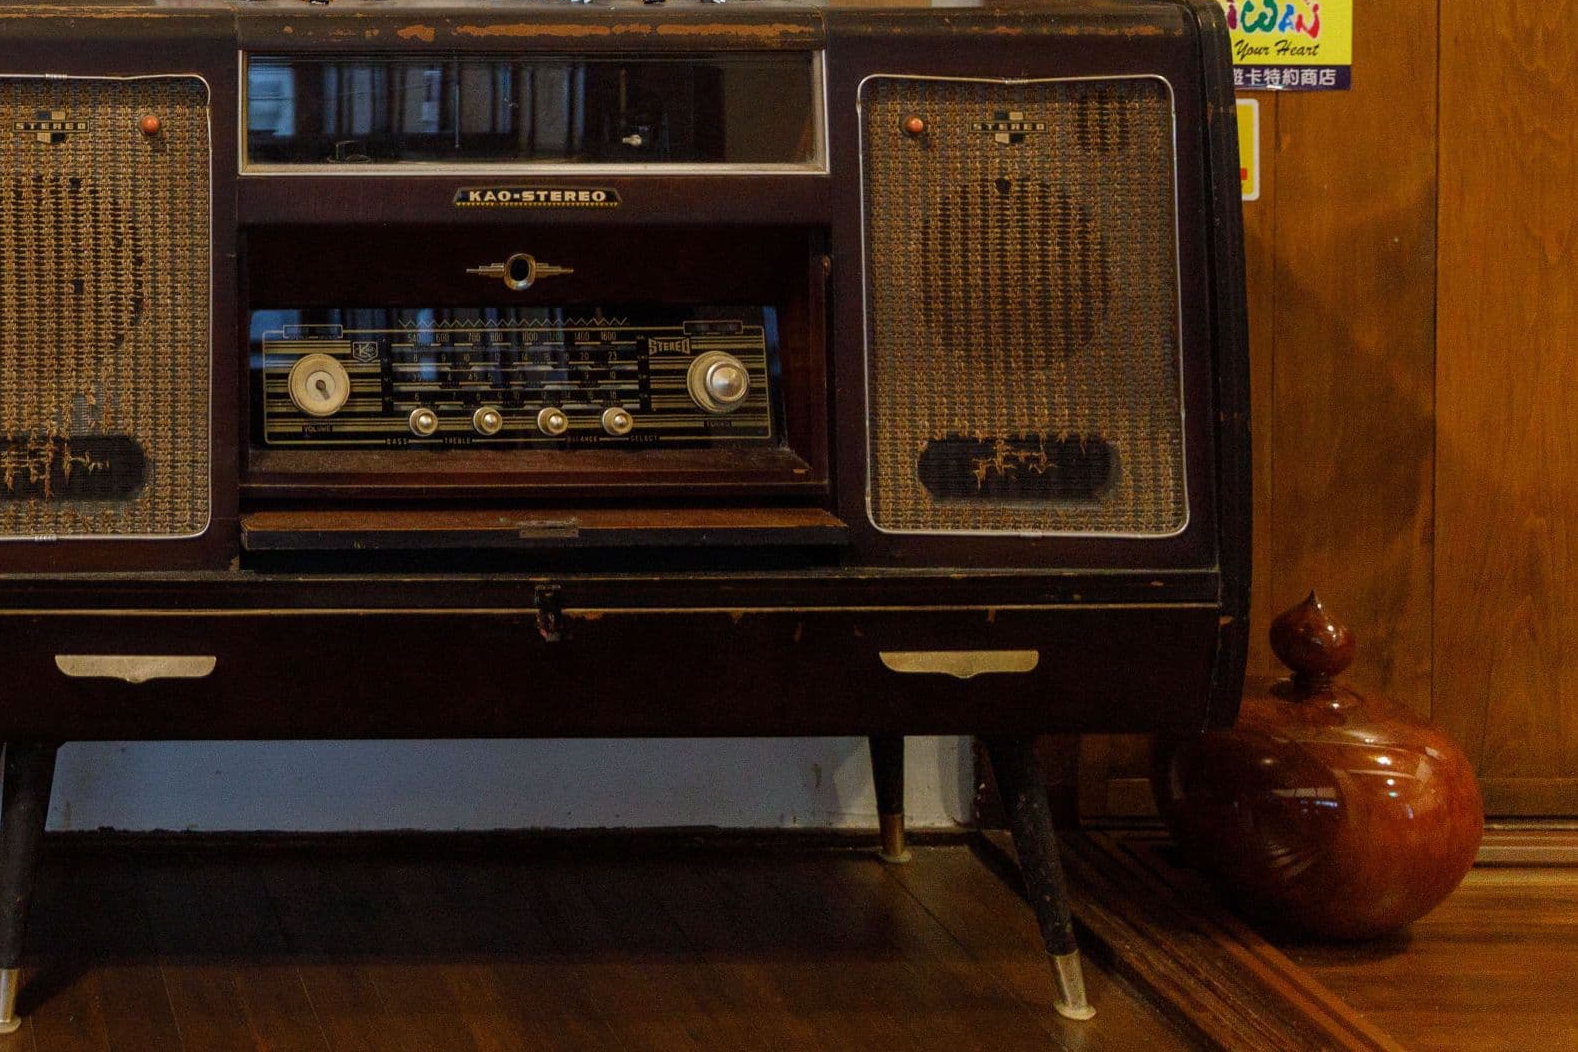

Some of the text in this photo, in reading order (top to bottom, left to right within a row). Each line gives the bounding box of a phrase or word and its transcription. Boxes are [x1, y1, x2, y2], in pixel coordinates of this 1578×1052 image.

[1234, 39, 1320, 61] Your Heart
[468, 188, 607, 203] KAO-STEREO
[648, 337, 691, 356] STEREO
